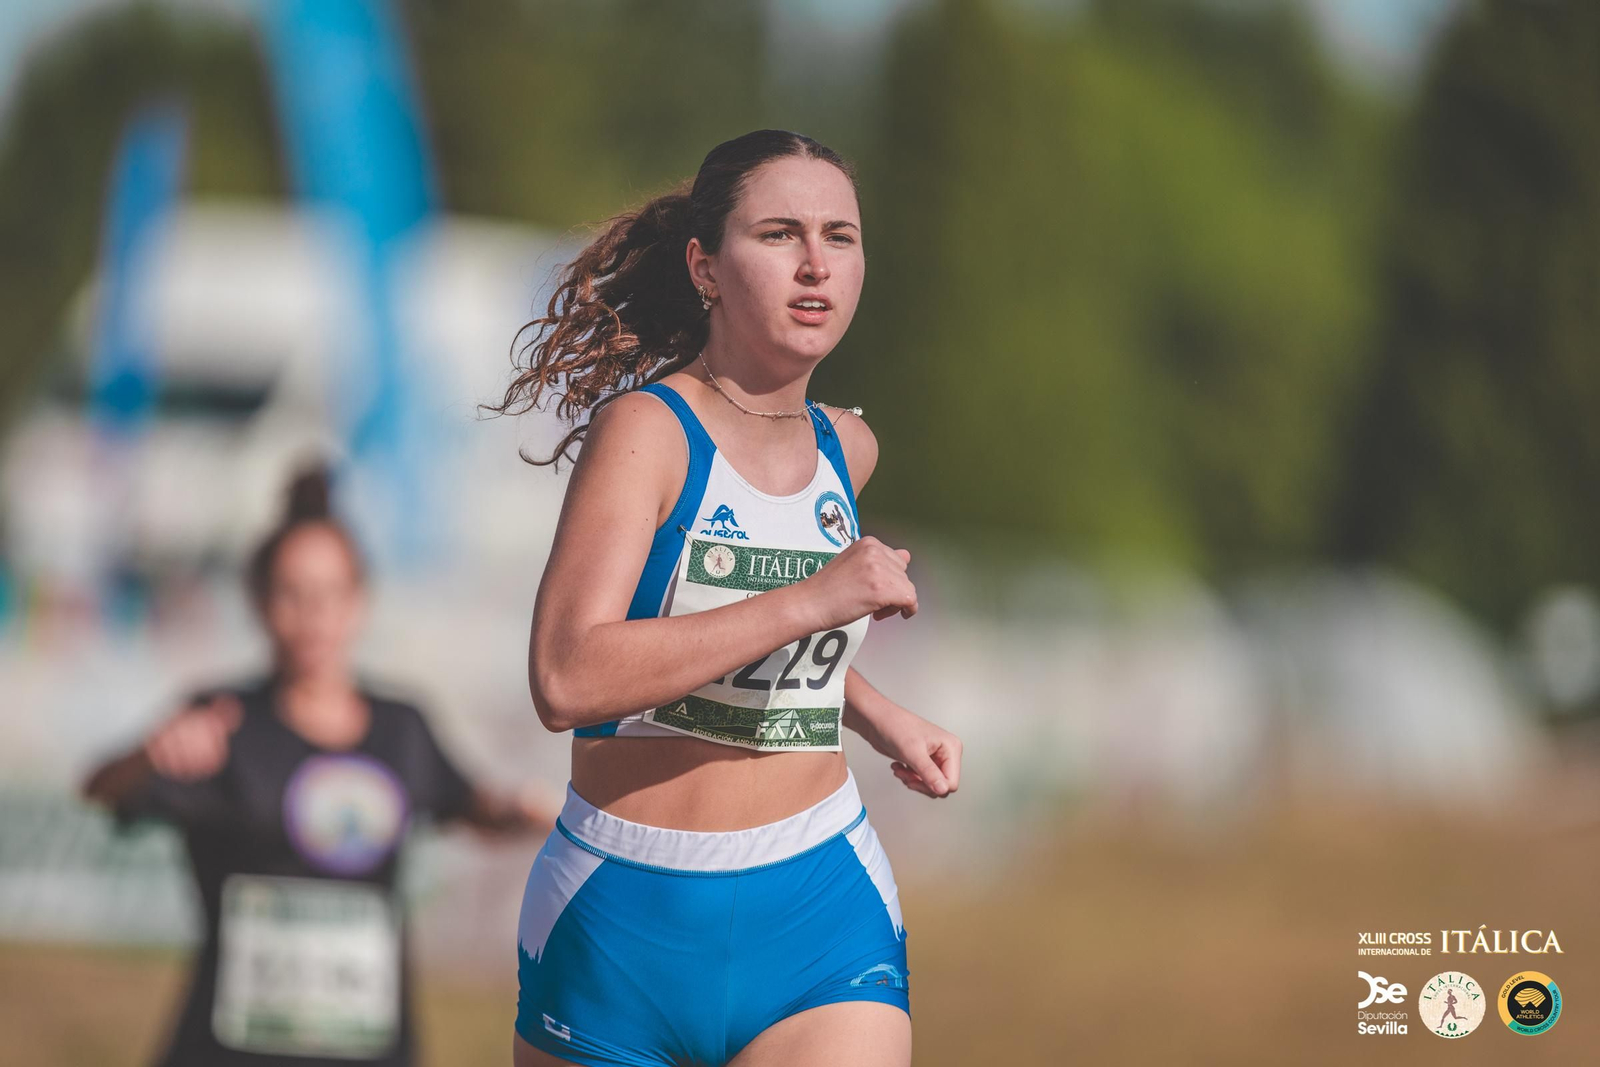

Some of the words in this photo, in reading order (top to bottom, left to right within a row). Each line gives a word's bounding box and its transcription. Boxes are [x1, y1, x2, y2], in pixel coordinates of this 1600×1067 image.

[713, 629, 849, 691] 229
[692, 727, 734, 743] FEDERACIÓN
[735, 737, 771, 748] ANDALUZA
[780, 740, 812, 748] ATLETISMO
